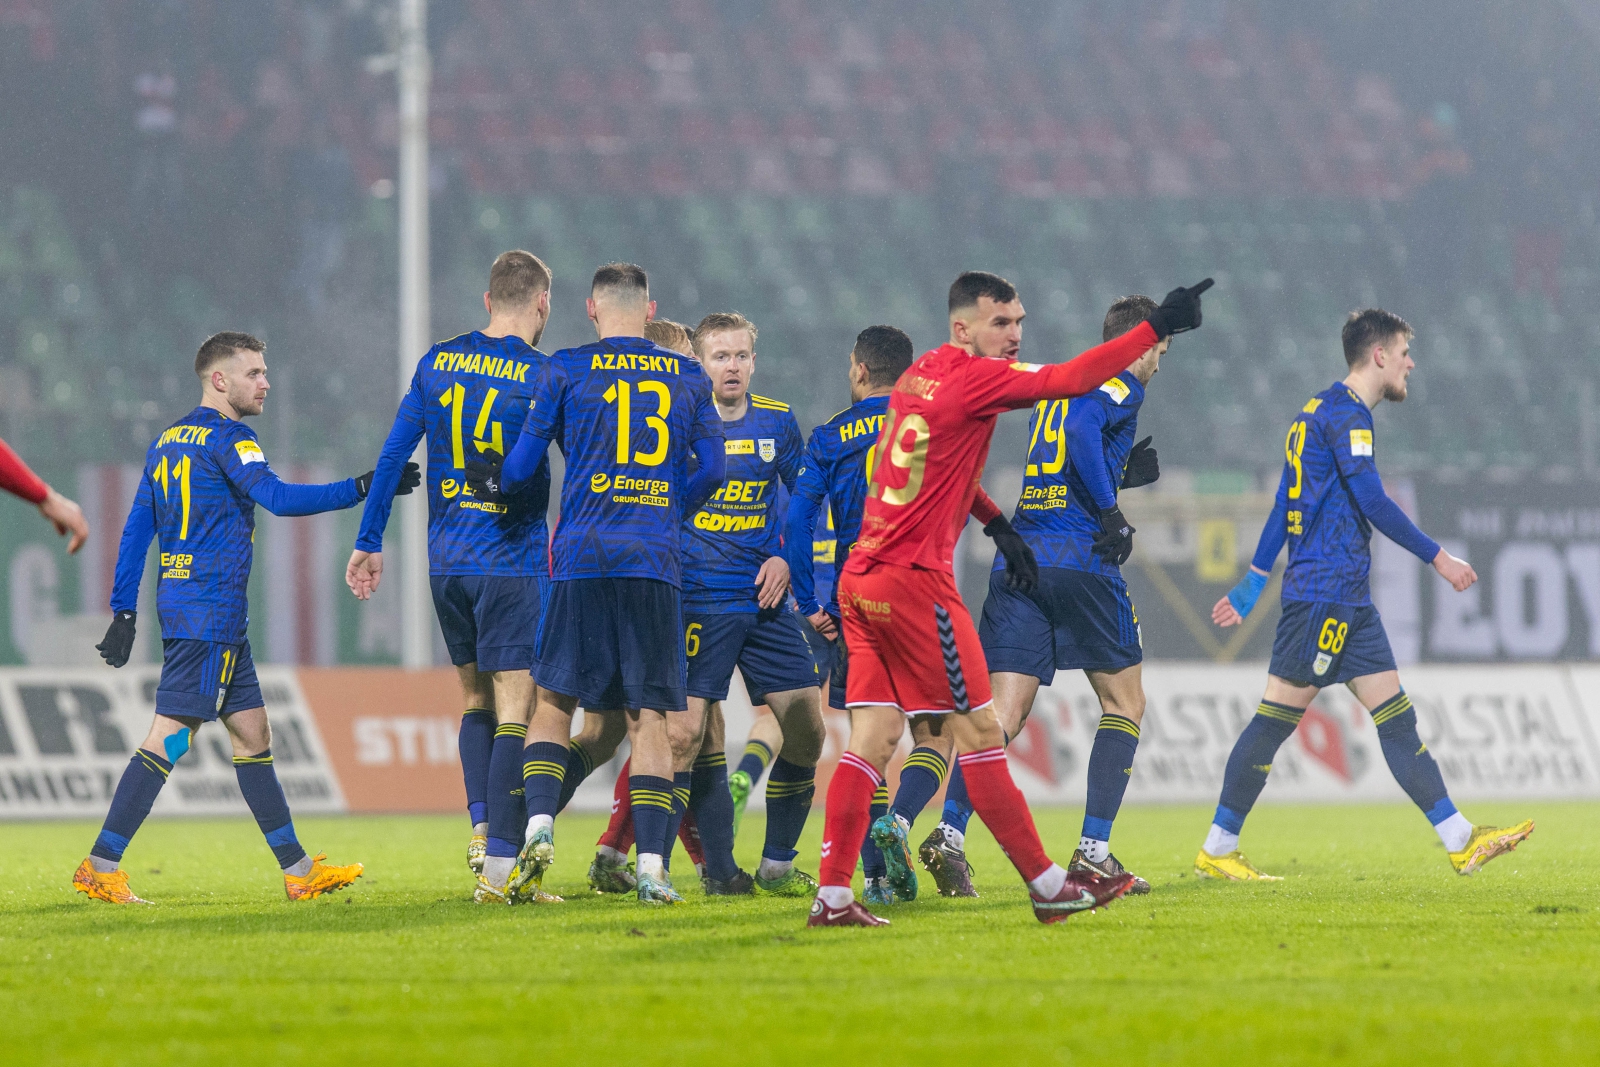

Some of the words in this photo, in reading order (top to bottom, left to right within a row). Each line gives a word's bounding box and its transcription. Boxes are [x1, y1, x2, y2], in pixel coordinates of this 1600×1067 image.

[433, 352, 530, 383] RYMANIAK
[591, 354, 680, 375] AZATSKYI
[439, 382, 504, 469] 14
[602, 379, 671, 466] 13
[152, 454, 191, 541] 11
[613, 475, 669, 495] Energa
[710, 480, 769, 502] rBET
[612, 495, 639, 504] GRUPA
[641, 496, 668, 505] ORLEN
[694, 511, 766, 532] GDYNIA
[1318, 617, 1348, 654] 68
